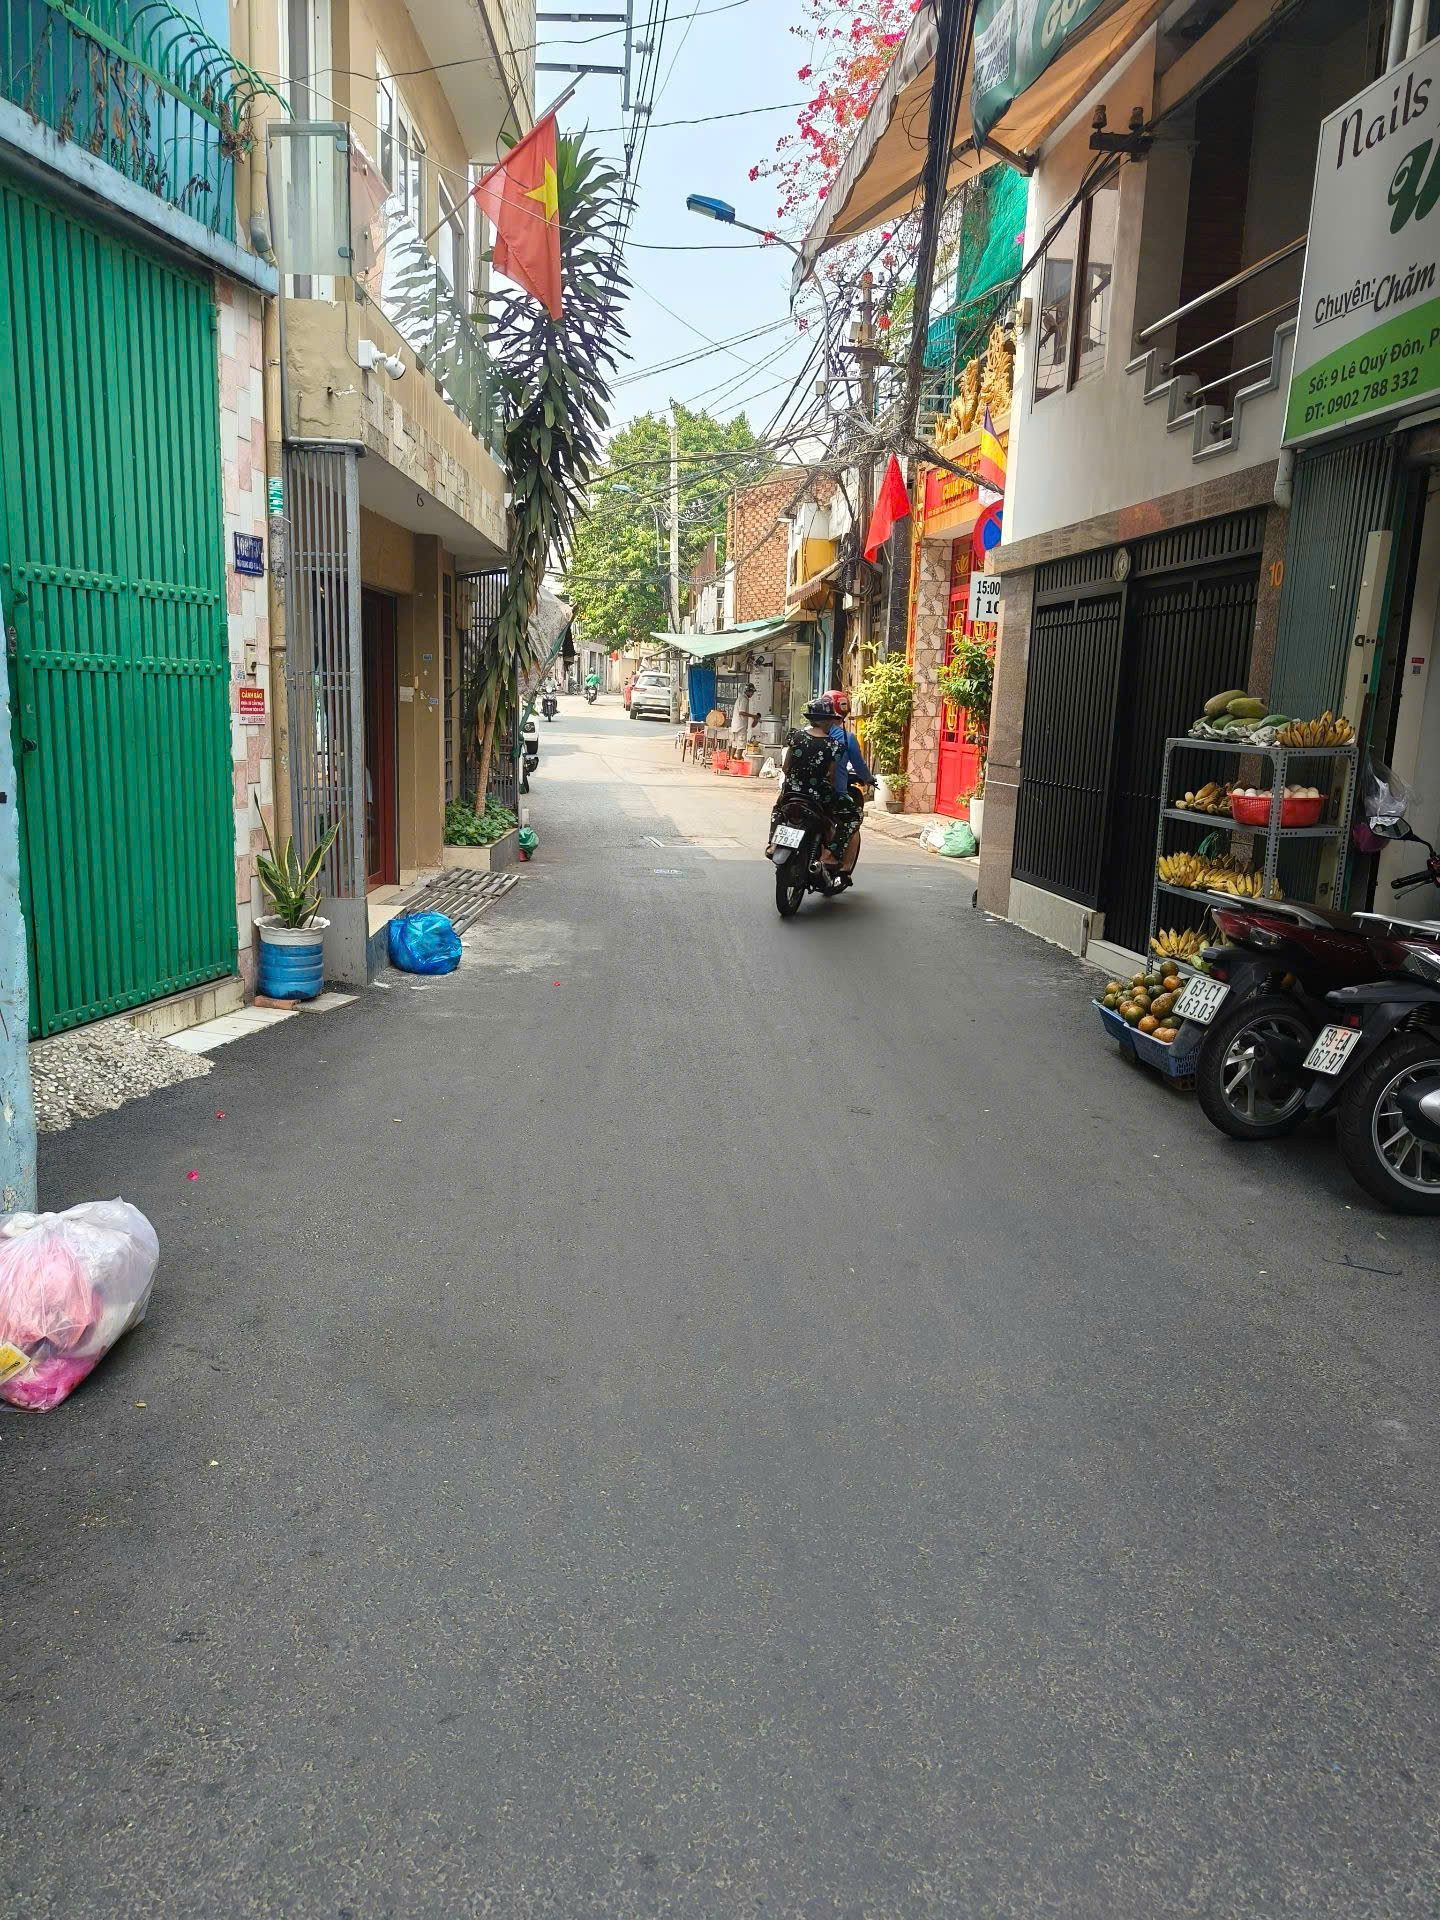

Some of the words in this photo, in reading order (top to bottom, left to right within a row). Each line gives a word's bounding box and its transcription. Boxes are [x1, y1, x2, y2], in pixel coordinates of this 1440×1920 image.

[1336, 71, 1433, 171] Nails
[1314, 278, 1376, 324] Chuyên:
[1373, 262, 1436, 313] Chăm
[1308, 369, 1328, 395] Số:
[1330, 369, 1339, 387] 9
[1341, 358, 1356, 382] Lê
[1359, 347, 1388, 375] Quý
[1389, 338, 1424, 363] Đôn,
[1305, 401, 1325, 423] ĐT:
[1327, 389, 1359, 416] 0902
[1362, 378, 1389, 403] 788
[1390, 366, 1419, 393] 332
[976, 580, 1000, 596] 15:00
[1269, 560, 1284, 587] 10
[1177, 995, 1216, 1021] 463.03
[1307, 1047, 1344, 1072] 067.97
